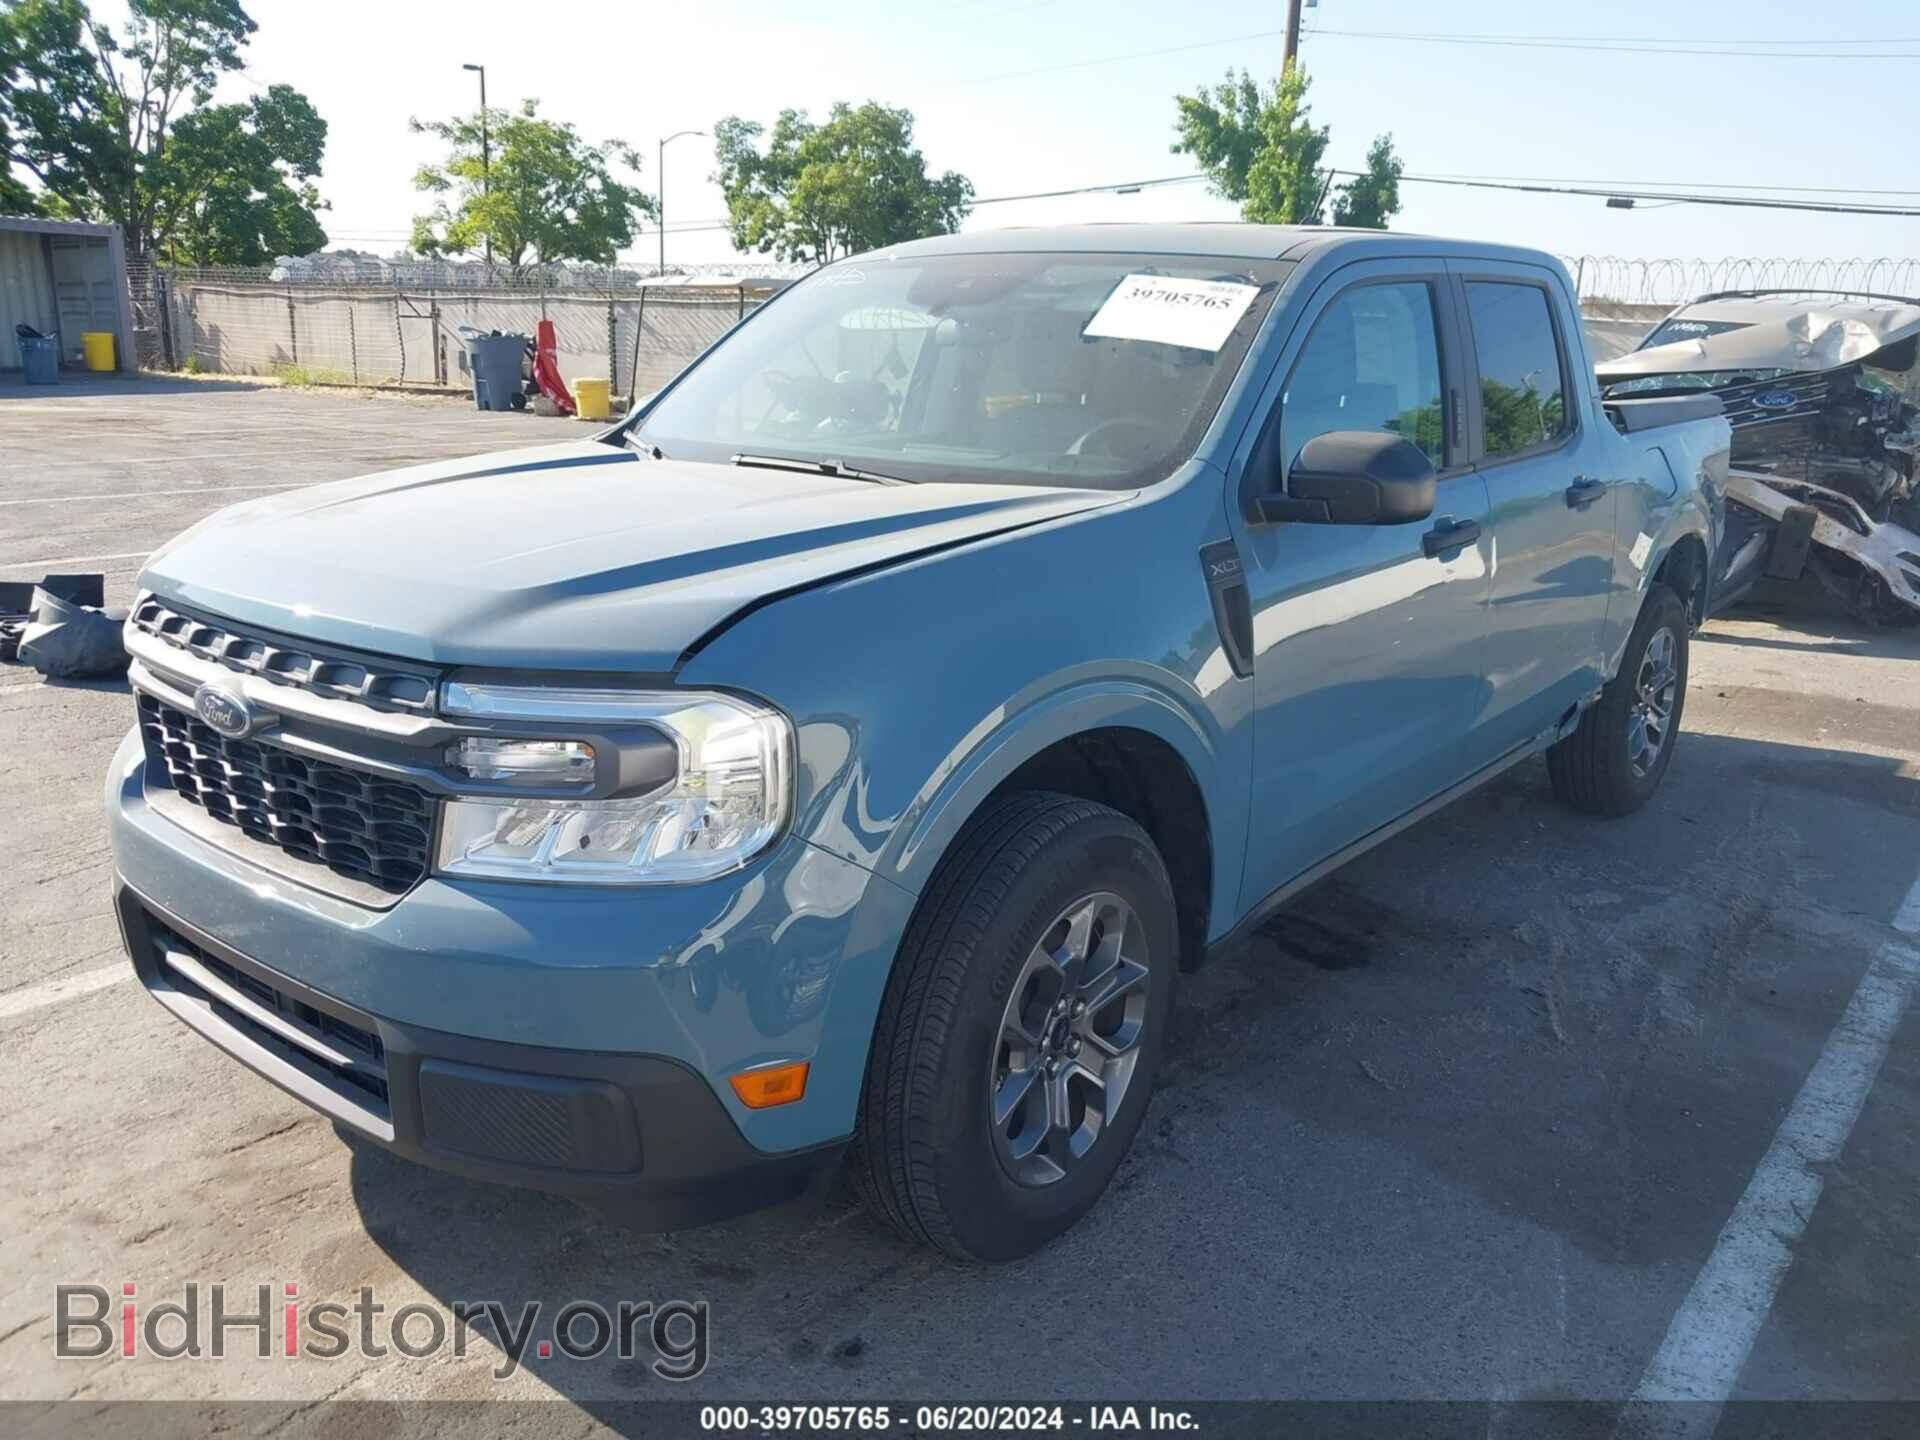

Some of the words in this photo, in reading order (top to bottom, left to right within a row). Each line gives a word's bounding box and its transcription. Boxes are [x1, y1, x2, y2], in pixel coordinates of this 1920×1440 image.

[1131, 286, 1233, 310] 39705765
[1761, 393, 1790, 405] Ford
[1209, 558, 1241, 577] XLT
[203, 694, 233, 727] Ford
